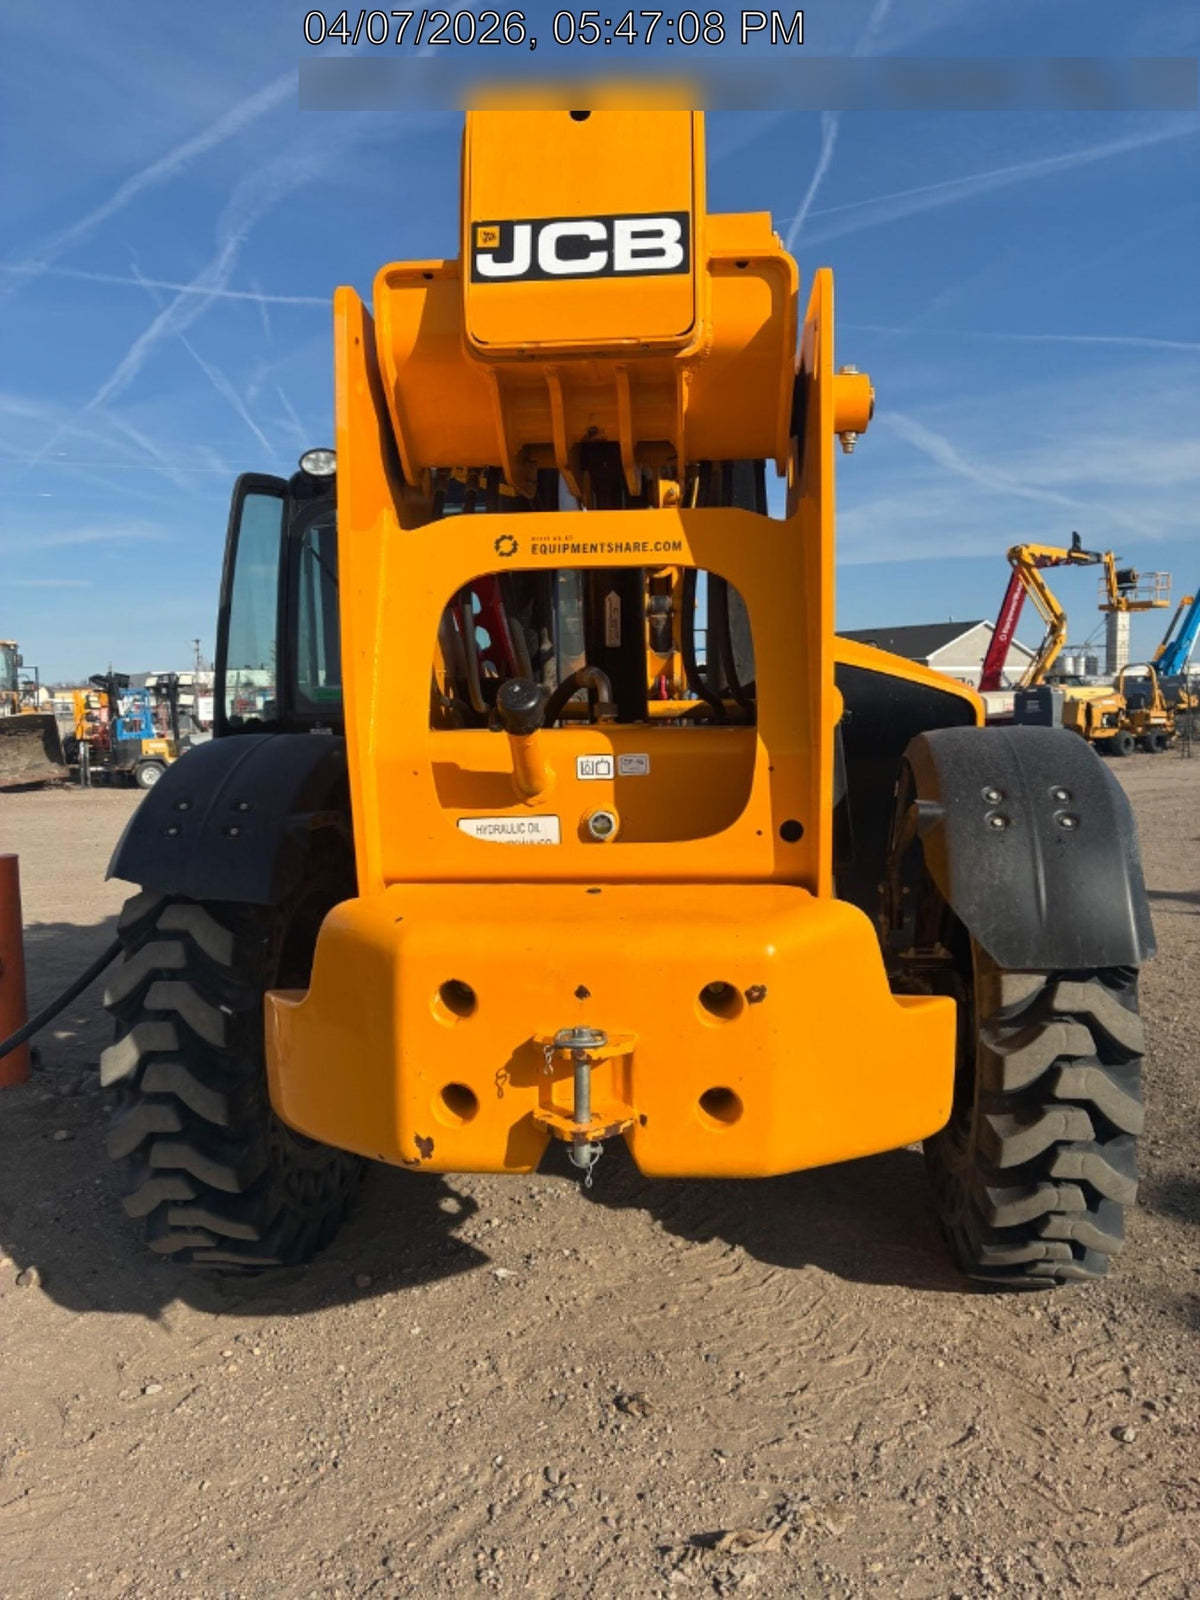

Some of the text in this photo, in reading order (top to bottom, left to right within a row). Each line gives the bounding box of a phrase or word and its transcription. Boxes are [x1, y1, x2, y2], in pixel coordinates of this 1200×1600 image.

[476, 218, 684, 277] JCB
[531, 540, 682, 555] EQUIPMENTSHARE.COM
[476, 822, 540, 835] HYDRAULIC OIL
